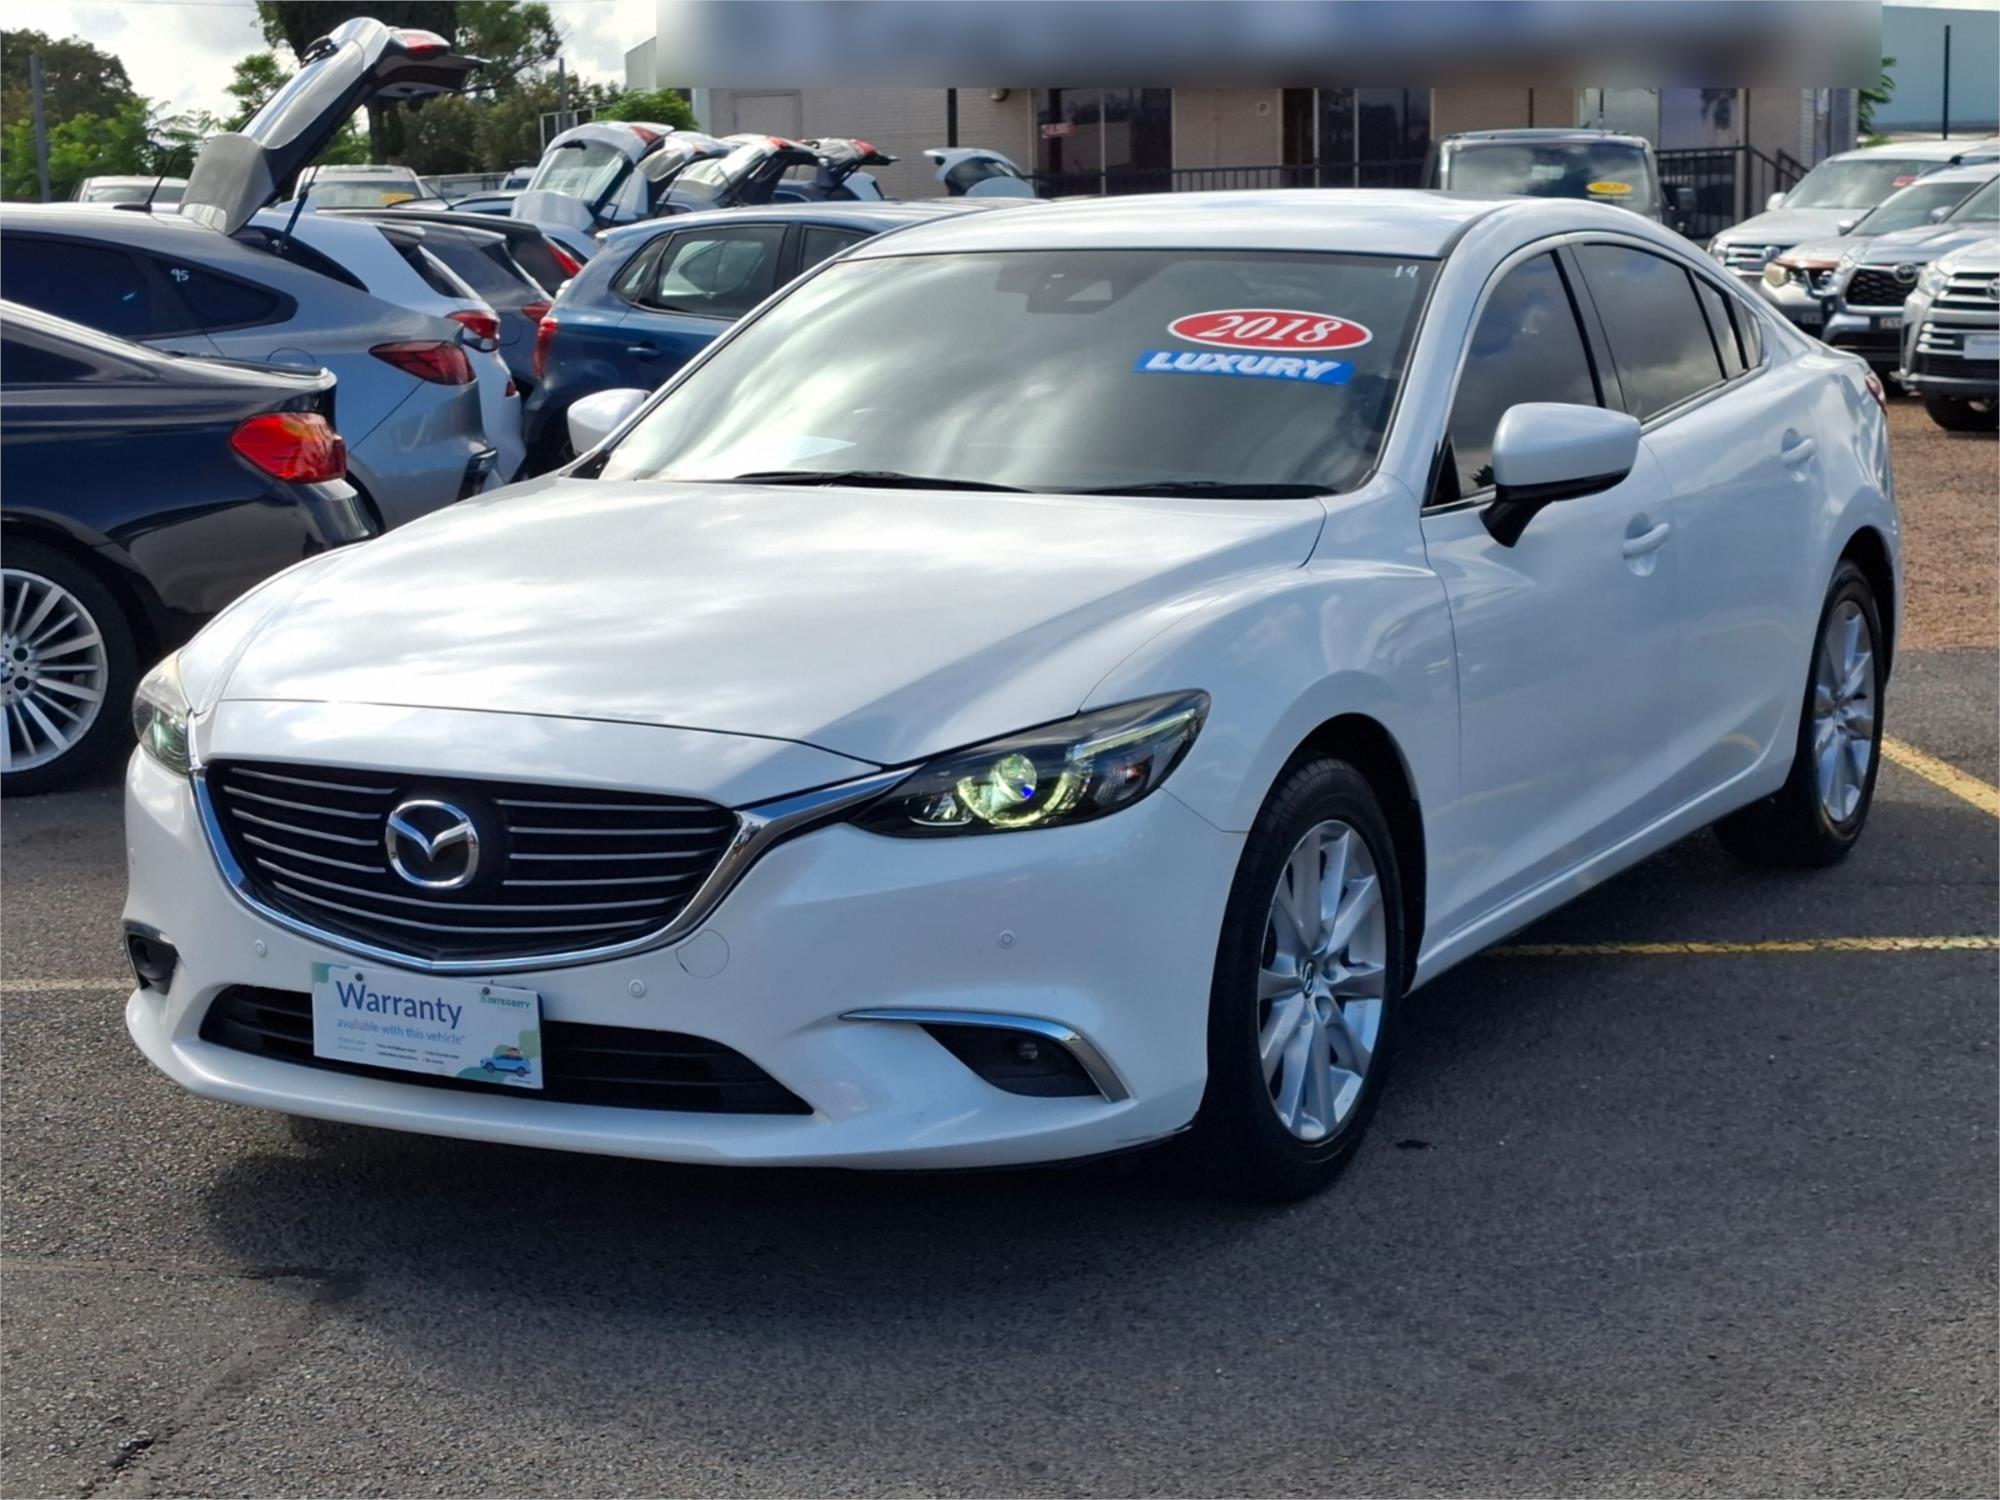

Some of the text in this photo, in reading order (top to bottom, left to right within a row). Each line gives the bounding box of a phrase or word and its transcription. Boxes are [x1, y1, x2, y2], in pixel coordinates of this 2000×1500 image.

[170, 268, 190, 282] 95
[1195, 315, 1343, 343] 2018
[1145, 351, 1342, 380] LUXURY
[336, 980, 462, 1030] Warranty
[336, 1018, 380, 1034] available
[381, 1023, 404, 1037] with
[406, 1027, 424, 1040] this
